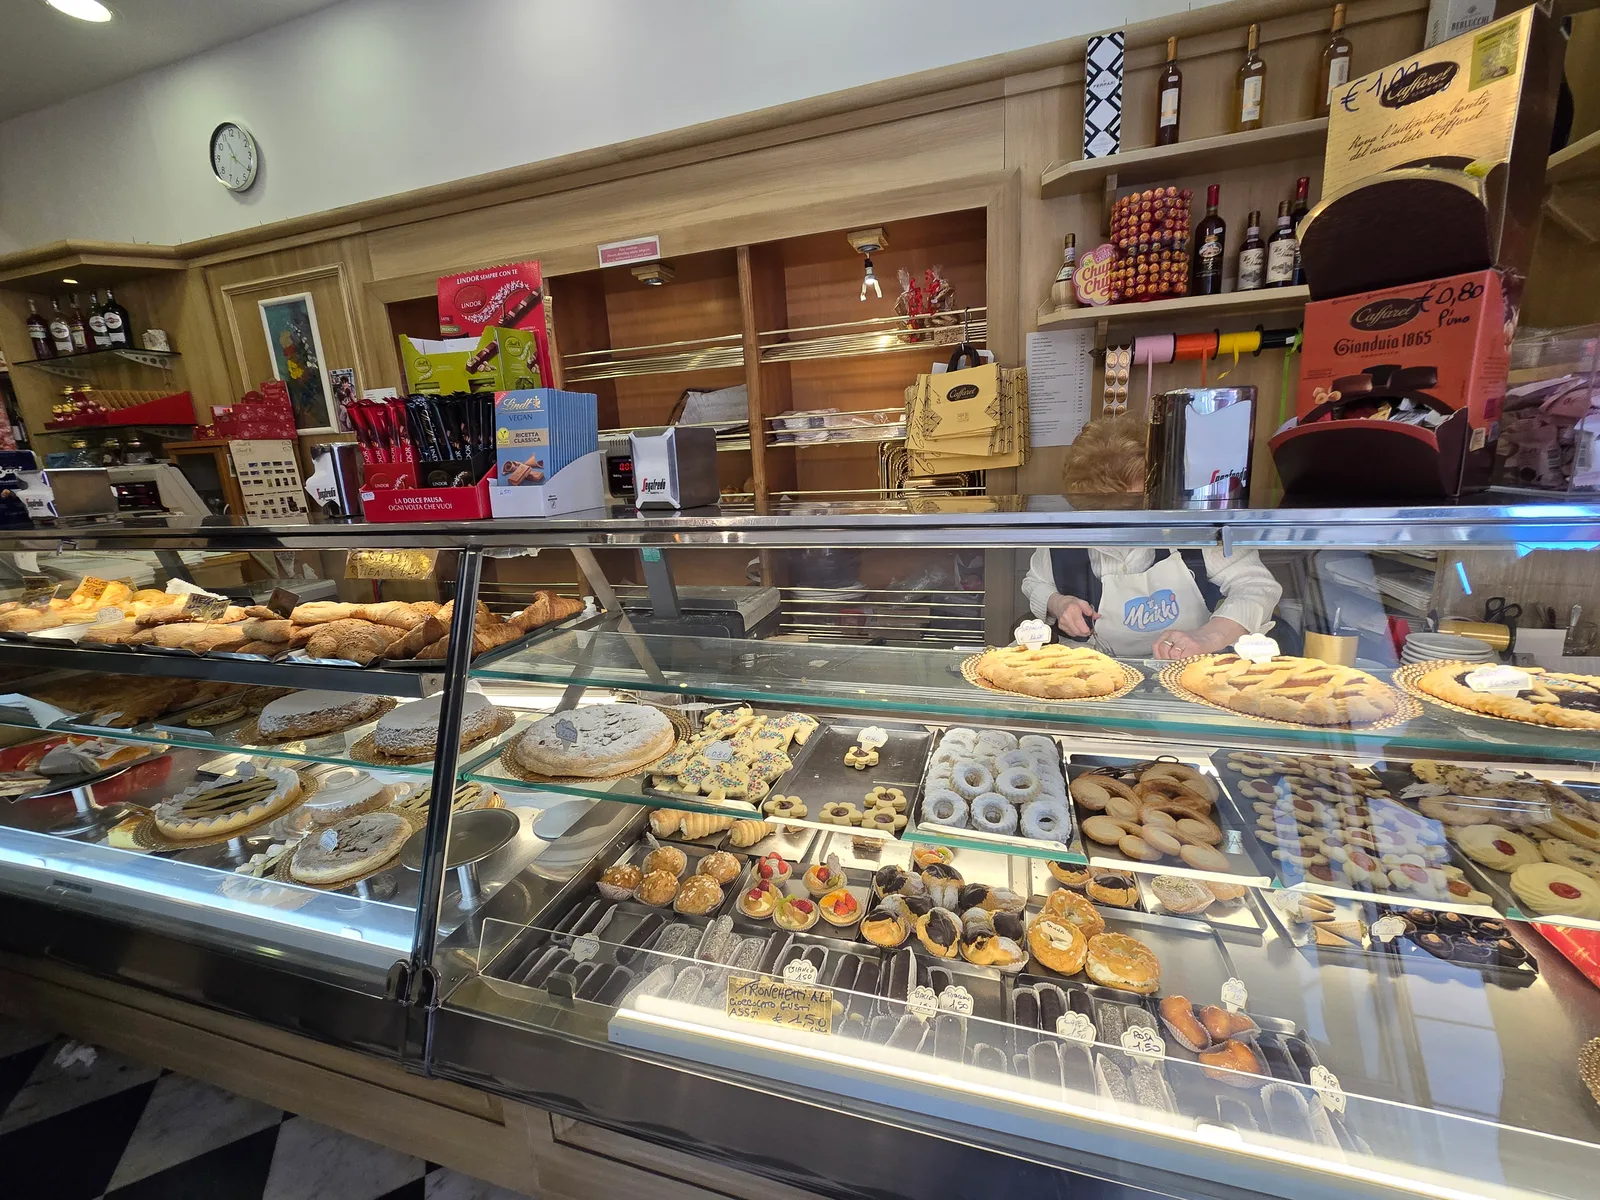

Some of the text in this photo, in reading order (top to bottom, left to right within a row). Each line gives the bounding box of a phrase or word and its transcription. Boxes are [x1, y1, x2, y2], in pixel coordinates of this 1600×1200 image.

[1451, 16, 1489, 30] BERLUCCHI
[1386, 64, 1455, 103] Caffarel
[1340, 78, 1367, 112] €
[1350, 102, 1490, 161] del cioccolato Caffarel
[456, 275, 480, 285] LINDOR
[461, 300, 481, 309] LINDOR
[1413, 286, 1434, 313] €
[1436, 282, 1484, 305] 0,80
[1355, 303, 1416, 326] Caffarel
[1334, 330, 1433, 357] Gianduia 1865
[949, 386, 976, 400] Caffarel
[502, 397, 533, 411] Lindt
[641, 478, 666, 493] Segafredo
[1123, 593, 1178, 630] Mukki
[810, 990, 828, 1003] AL
[780, 1002, 810, 1012] GUSTI
[787, 1013, 827, 1028] 1,50
[1133, 1030, 1154, 1042] ROSA
[1133, 1041, 1161, 1053] 1,50
